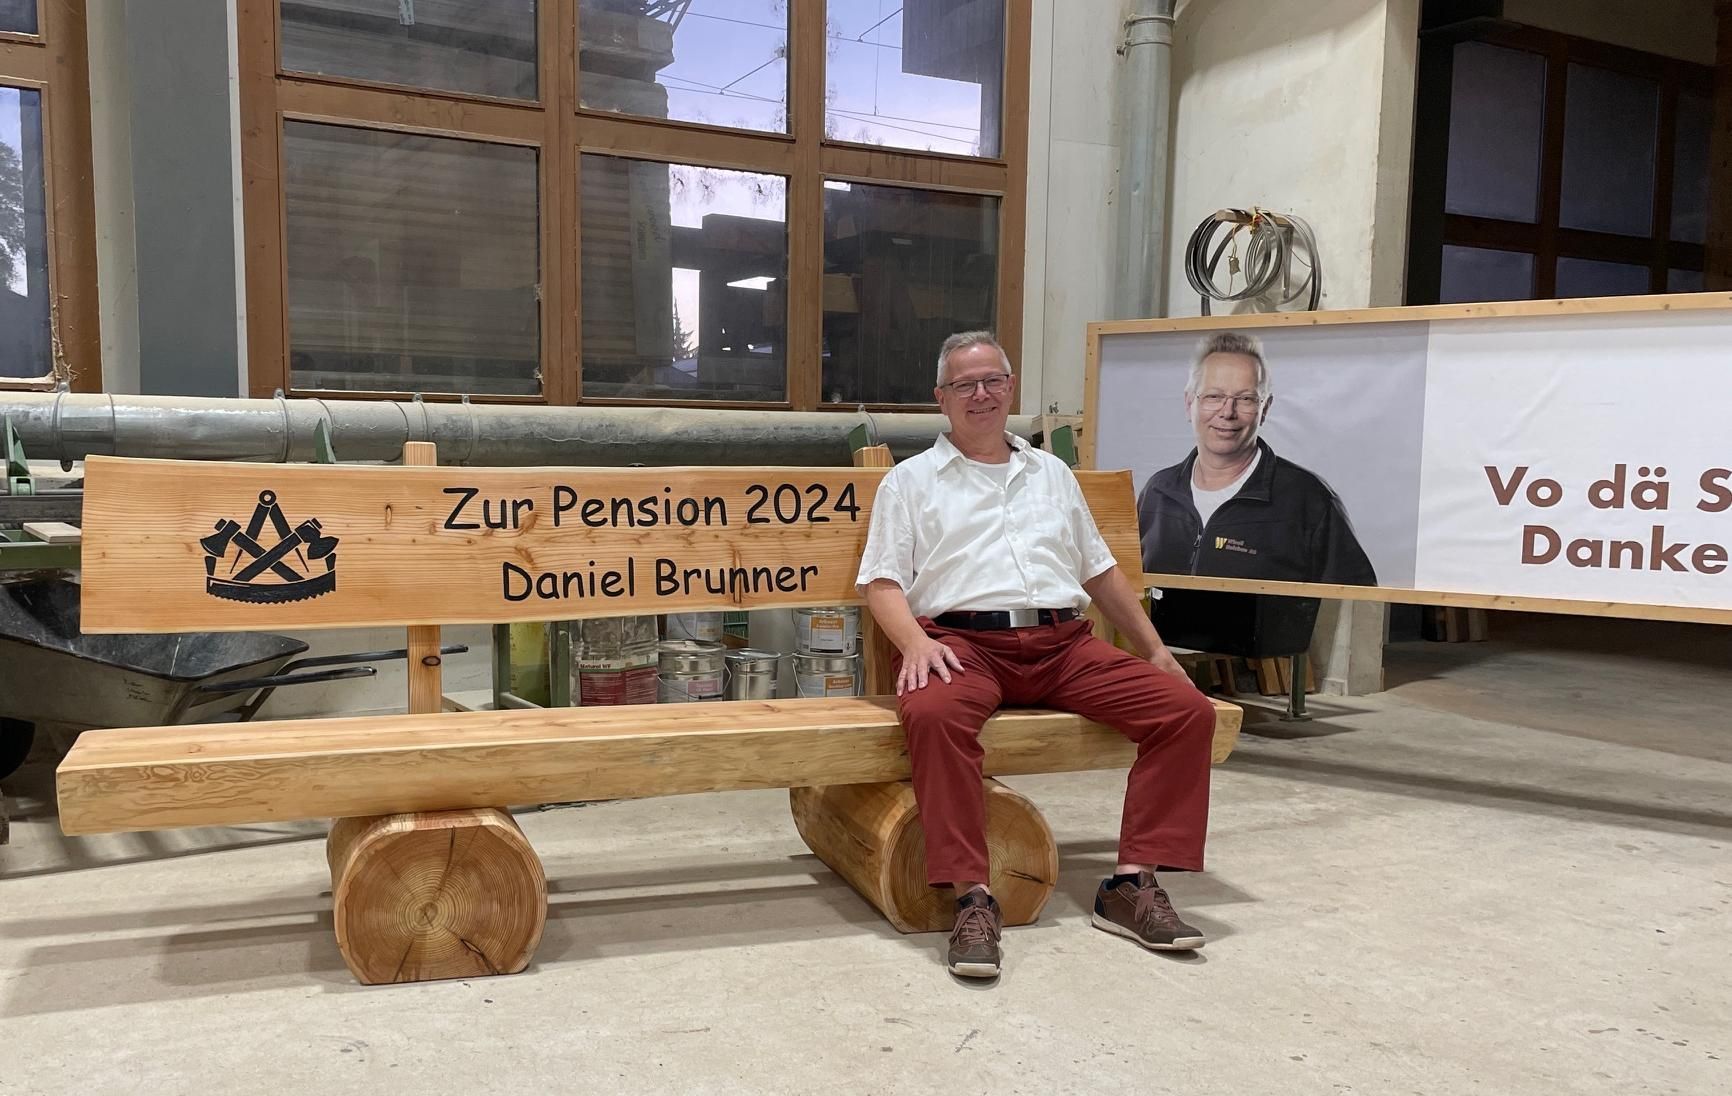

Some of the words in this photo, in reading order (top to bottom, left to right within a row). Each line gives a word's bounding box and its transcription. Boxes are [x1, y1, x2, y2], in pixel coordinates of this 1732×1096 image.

[442, 487, 534, 530] Zur
[553, 485, 728, 528] Pension
[745, 482, 861, 525] 2024
[1483, 465, 1563, 508] Vo
[1587, 463, 1670, 511] dä
[1521, 524, 1729, 575] Danke
[502, 556, 635, 602] Daniel
[655, 558, 819, 597] Brunner
